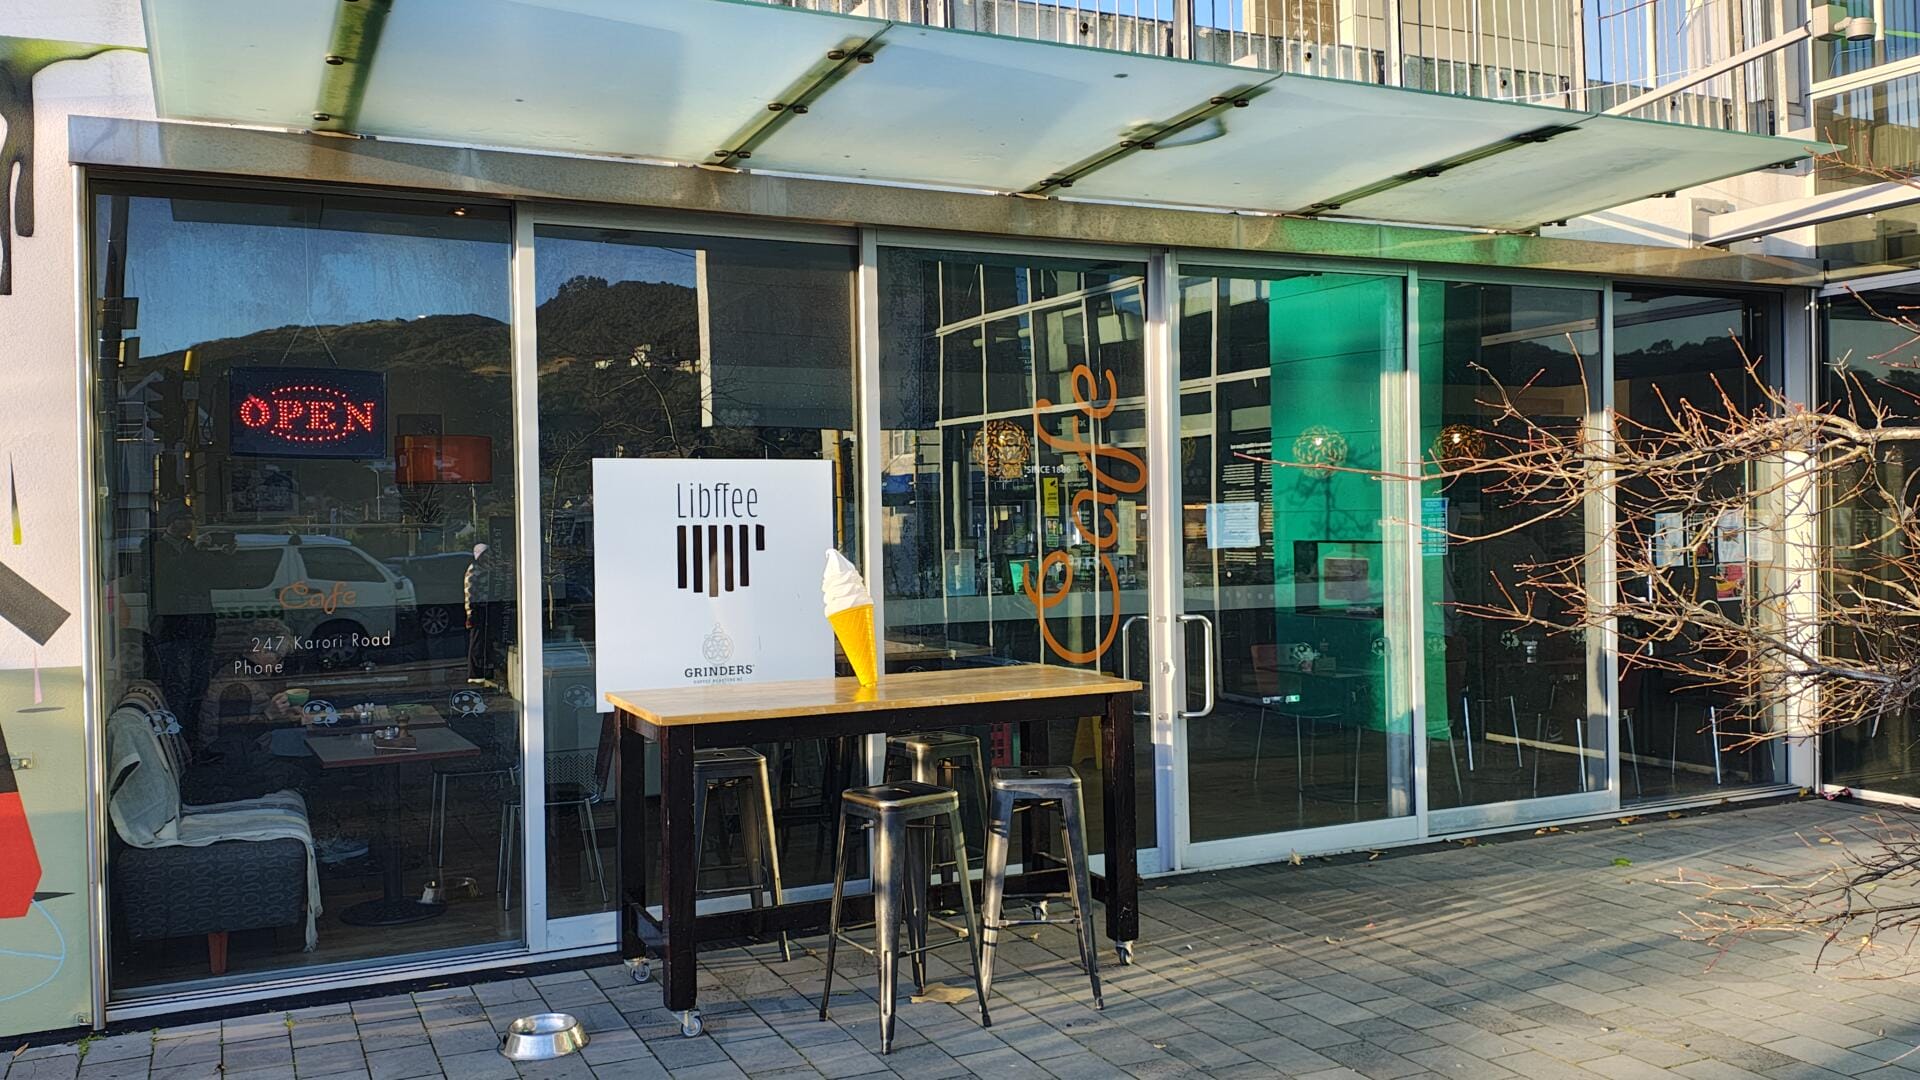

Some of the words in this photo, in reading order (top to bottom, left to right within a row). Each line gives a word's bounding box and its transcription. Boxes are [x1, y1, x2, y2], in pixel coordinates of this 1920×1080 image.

[239, 397, 376, 433] OPEN
[677, 482, 758, 518] Libffee
[1023, 364, 1148, 664] Cafe
[279, 581, 356, 614] Cafe
[251, 636, 285, 652] 247
[294, 635, 343, 650] Karori
[352, 630, 391, 647] Road
[234, 660, 284, 675] Phone
[684, 664, 753, 678] GRINDERS
